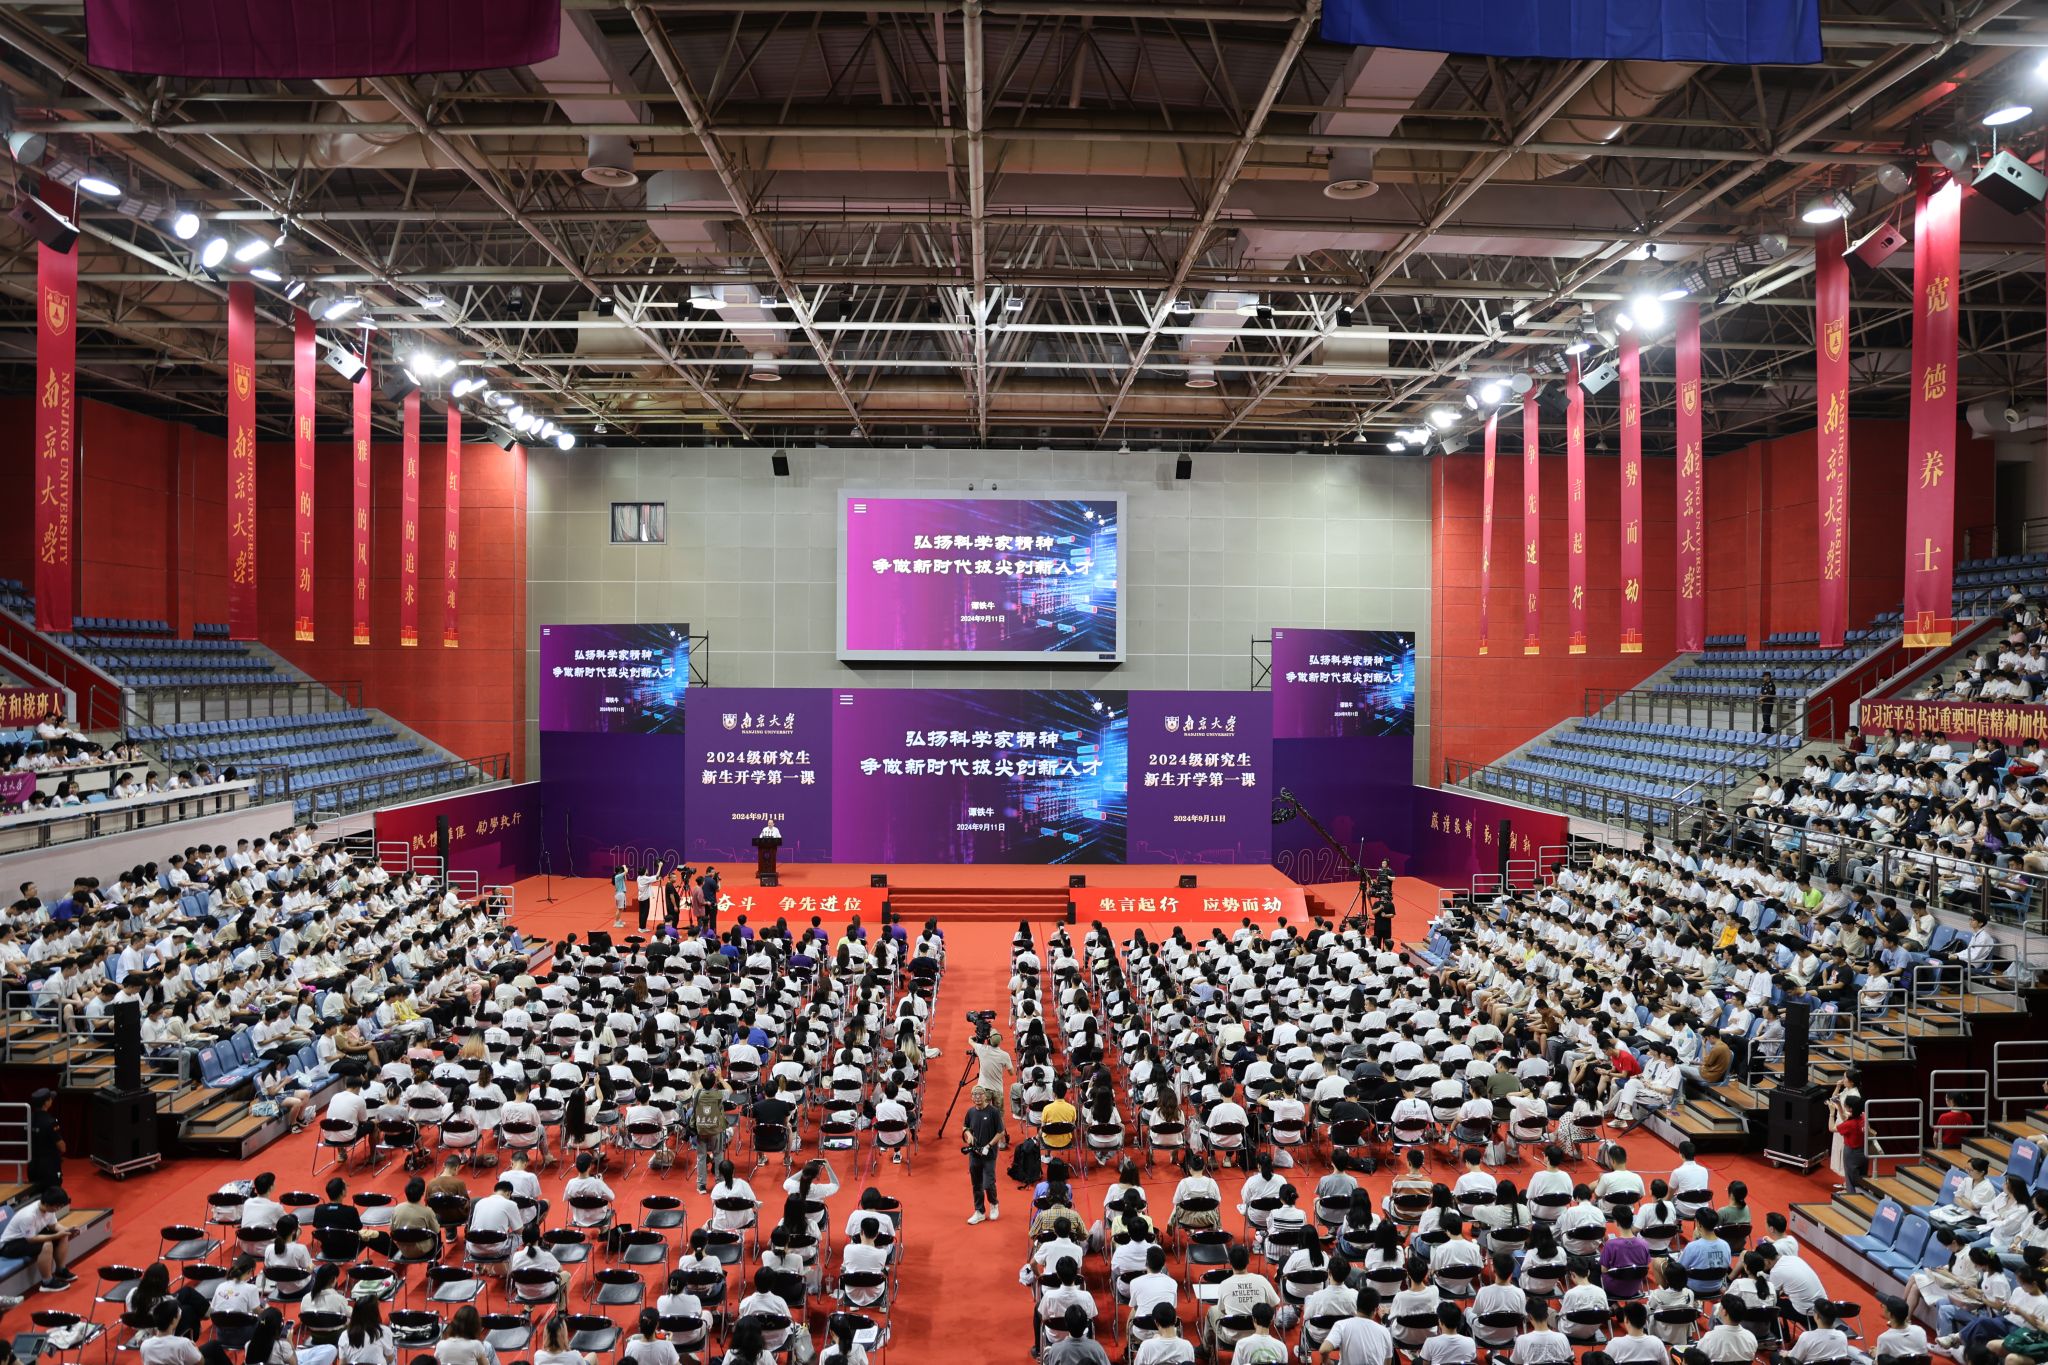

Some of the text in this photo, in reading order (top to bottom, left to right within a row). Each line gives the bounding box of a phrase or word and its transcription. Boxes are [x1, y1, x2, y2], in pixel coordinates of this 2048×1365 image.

[1914, 277, 1950, 573] 宽德养士
[59, 372, 71, 565] NANJING UNIVERSITY
[1834, 388, 1846, 577] NANJING UNIVERSITY
[1625, 403, 1640, 604] 应势而动
[1572, 425, 1584, 611] 坐言起行
[1526, 443, 1538, 614] 争先进位
[247, 497, 255, 585] UNIVERSITY
[913, 534, 1055, 551] 弘扬科学家精神
[872, 558, 1095, 576] 争做新时代拔尖创新人才
[970, 601, 996, 610] 谭铁牛
[960, 615, 1005, 623] 2024年9月11日
[574, 649, 653, 661] 弘扬科学家精神
[1309, 654, 1384, 667] 弘扬科学家精神
[552, 666, 676, 679] 争做新时代拔尖创新人才
[1286, 671, 1405, 684] 争做新时代拔尖创新人才
[1861, 703, 2048, 741] 以习近平总书记重要回信精神加快
[905, 730, 1060, 749] 弘扬科学家精神
[706, 750, 811, 765] 2024级研究生
[1148, 752, 1252, 767] 2024级研究生
[860, 757, 1104, 777] 争做新时代拔尖创新人才
[701, 769, 816, 785] 新生开学第一课
[1143, 771, 1256, 788] 新生开学第一课
[731, 812, 785, 821] 2024年9月11日
[968, 807, 995, 818] 谭铁牛
[1173, 814, 1227, 823] 2024年9月11日
[956, 822, 1006, 832] 2024年9月11日
[778, 894, 862, 913] 争先进位
[1098, 895, 1283, 913] 坐言起行 应势而动
[1232, 1289, 1260, 1297] ATHLETIC
[1237, 1282, 1253, 1290] NIKE
